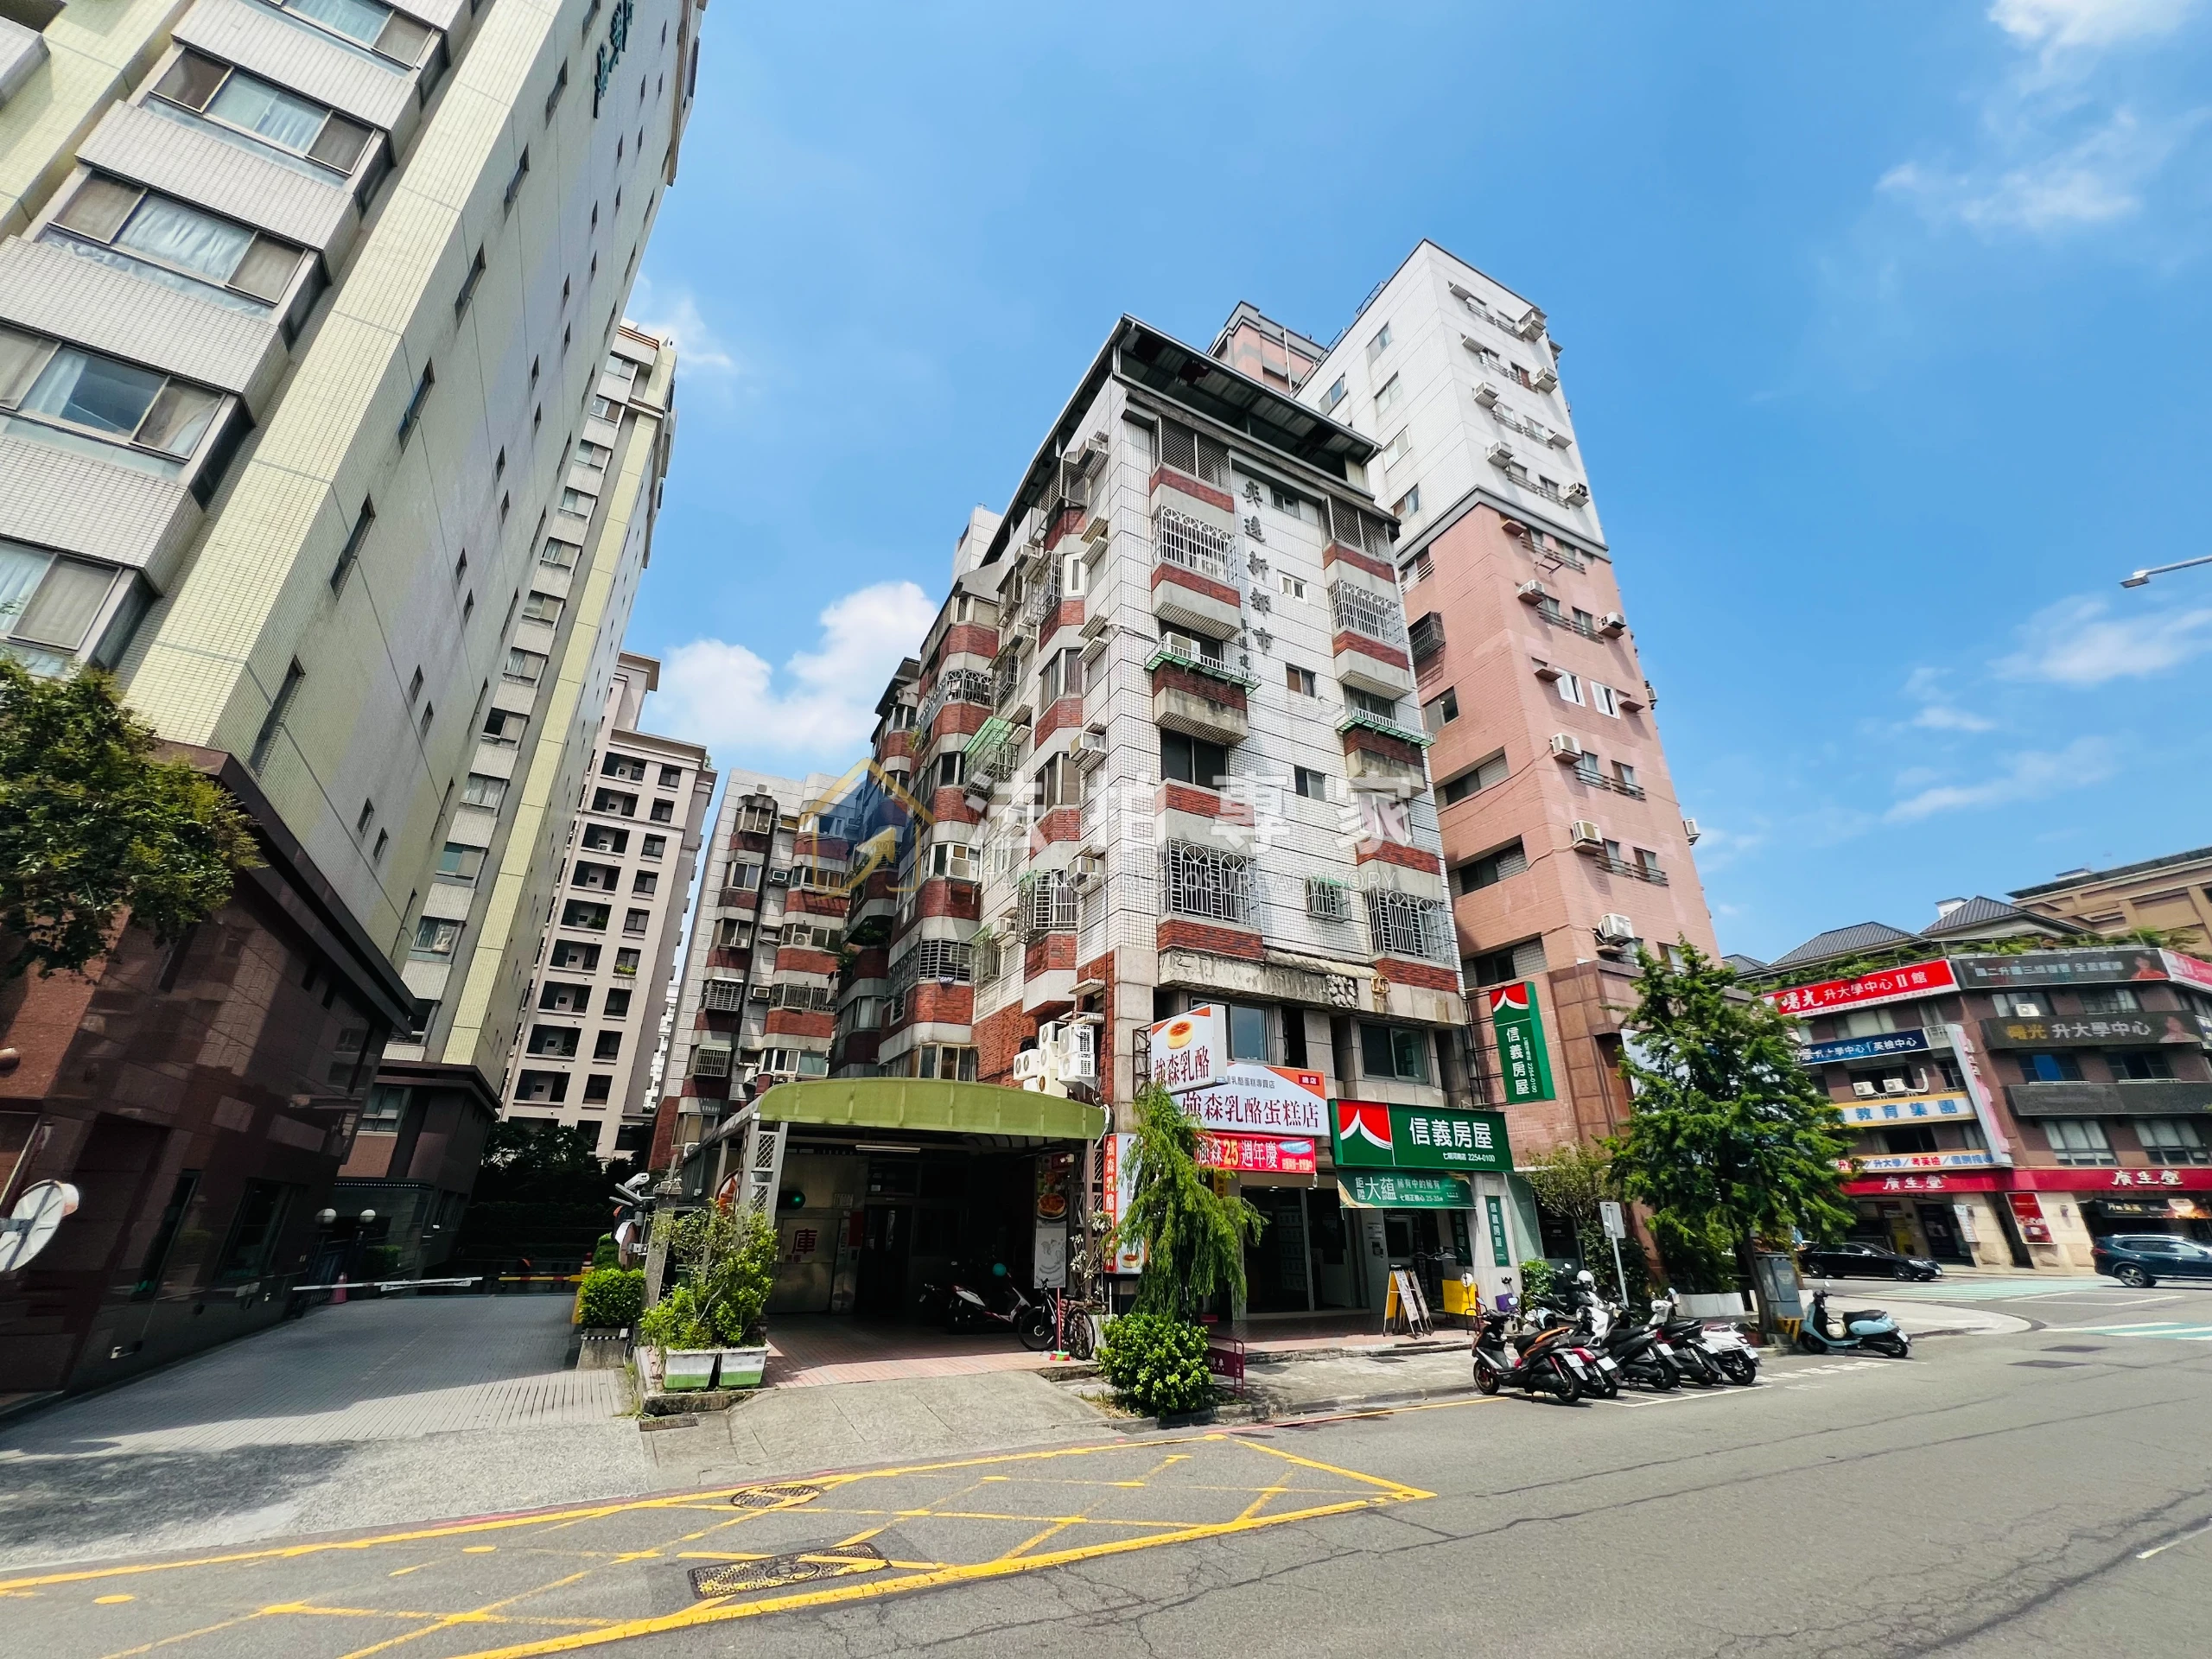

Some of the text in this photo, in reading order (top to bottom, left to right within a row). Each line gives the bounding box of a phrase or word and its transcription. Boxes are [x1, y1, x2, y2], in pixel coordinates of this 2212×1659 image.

[2052, 1021, 2151, 1039] 升大學中心
[1154, 1046, 1210, 1088] 強森乳酪
[1506, 1027, 1529, 1096] 信義房屋
[1182, 1091, 1319, 1128] 強森乳酪蛋糕店
[1409, 1116, 1493, 1149] 信義房屋
[1396, 1178, 1440, 1191] 稀有中的稀有
[2111, 1169, 2183, 1186] 廣生堂
[791, 1228, 818, 1255] 庫
